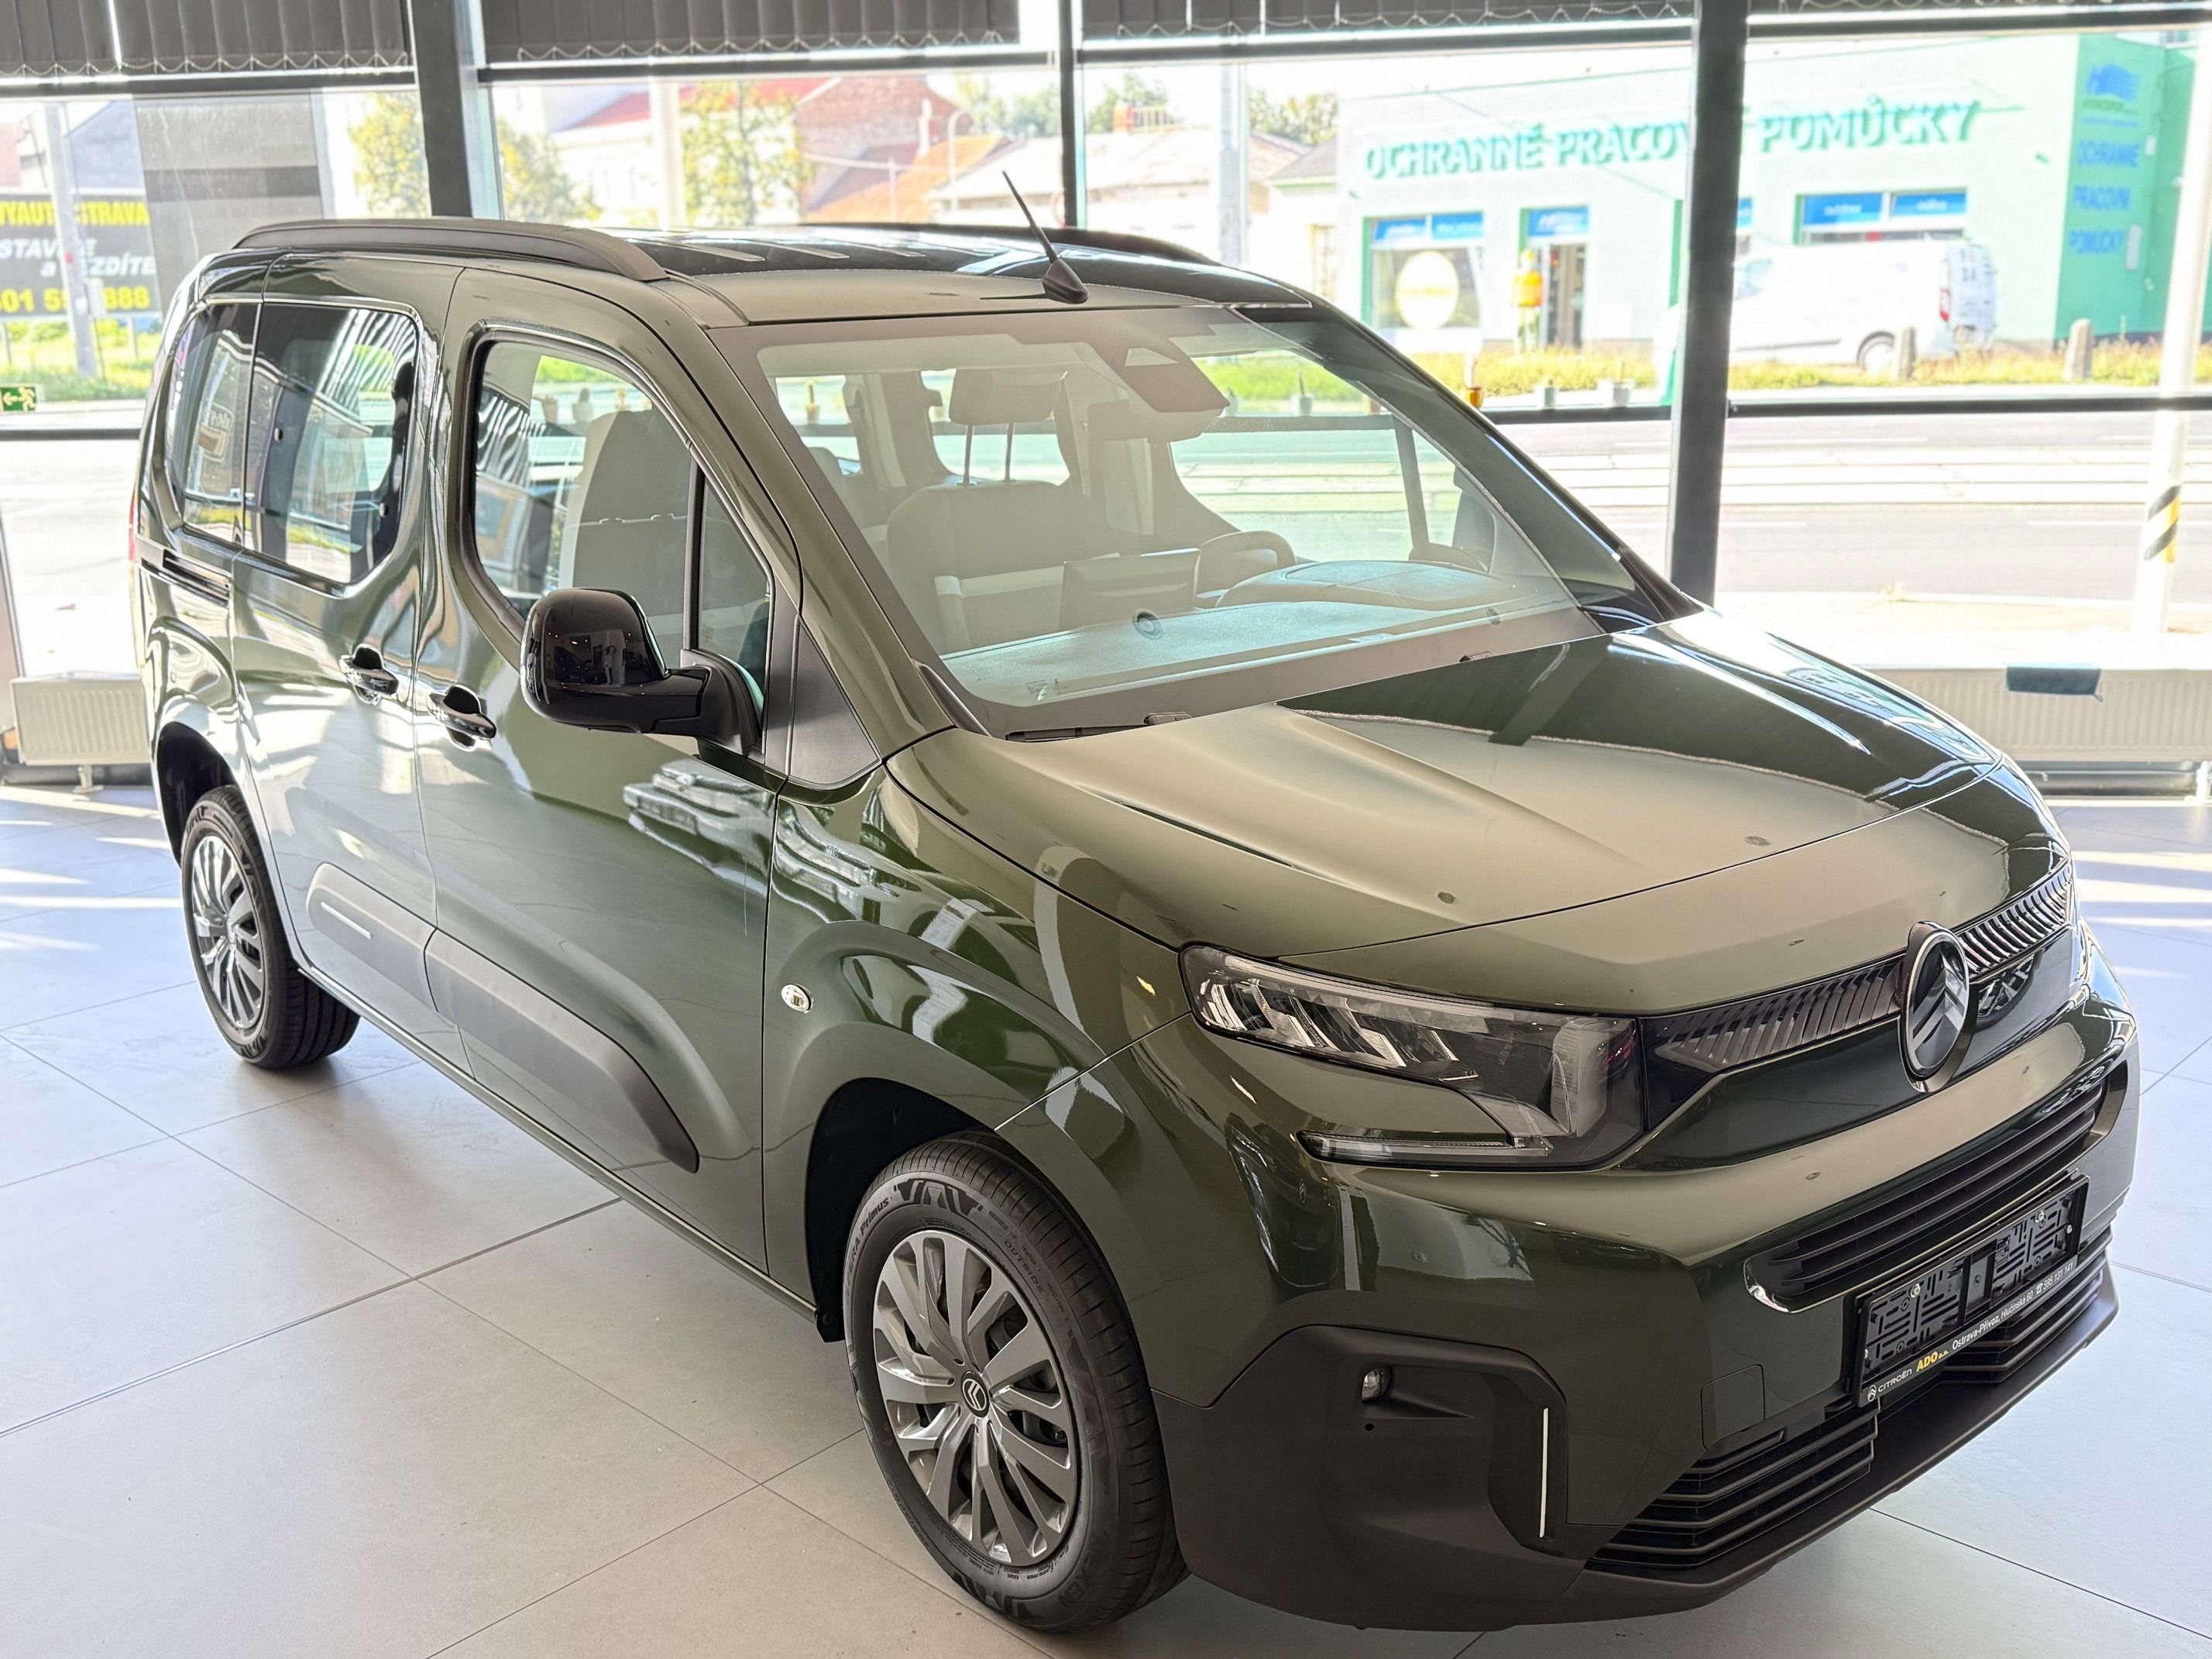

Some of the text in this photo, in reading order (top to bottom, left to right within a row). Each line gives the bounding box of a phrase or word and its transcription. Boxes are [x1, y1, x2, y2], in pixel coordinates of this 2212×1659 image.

[1365, 122, 1545, 179] OCHRANNÉ
[1759, 94, 1980, 153] POMŮCKY
[859, 1197, 890, 1235] Primus
[1004, 1240, 1045, 1293] OUTSIDE
[1877, 1368, 1912, 1393] CITROËN
[1915, 1351, 1939, 1372] ADO
